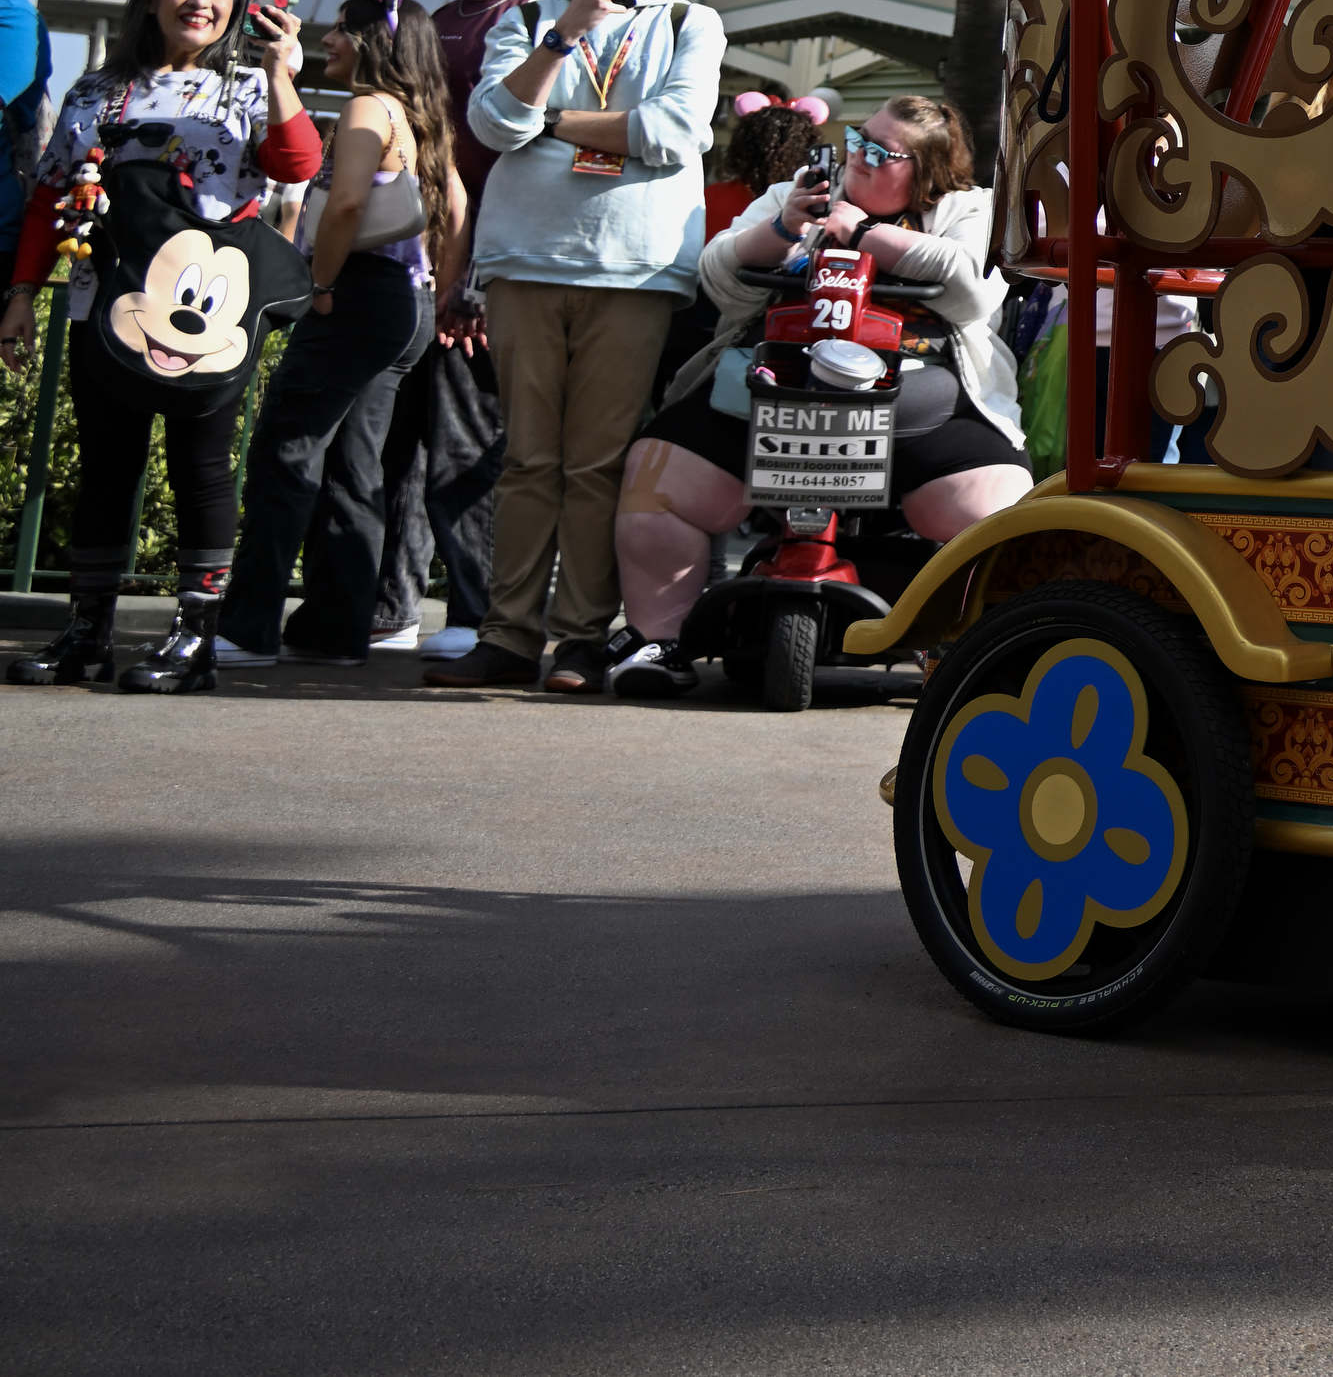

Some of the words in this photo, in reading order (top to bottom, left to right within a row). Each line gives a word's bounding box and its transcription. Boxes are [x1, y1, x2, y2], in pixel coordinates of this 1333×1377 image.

[808, 268, 868, 295] Select
[812, 298, 853, 330] 29
[756, 405, 838, 430] RENT
[848, 409, 890, 431] ME
[758, 436, 884, 456] SELECT
[756, 458, 800, 468] MOBILITY
[803, 460, 848, 470] SCOOTER
[771, 474, 866, 487] 714-644-8057
[751, 492, 884, 503] WWW.ASELECTMOBILITY.COM
[1007, 993, 1060, 1008] PICK-UP
